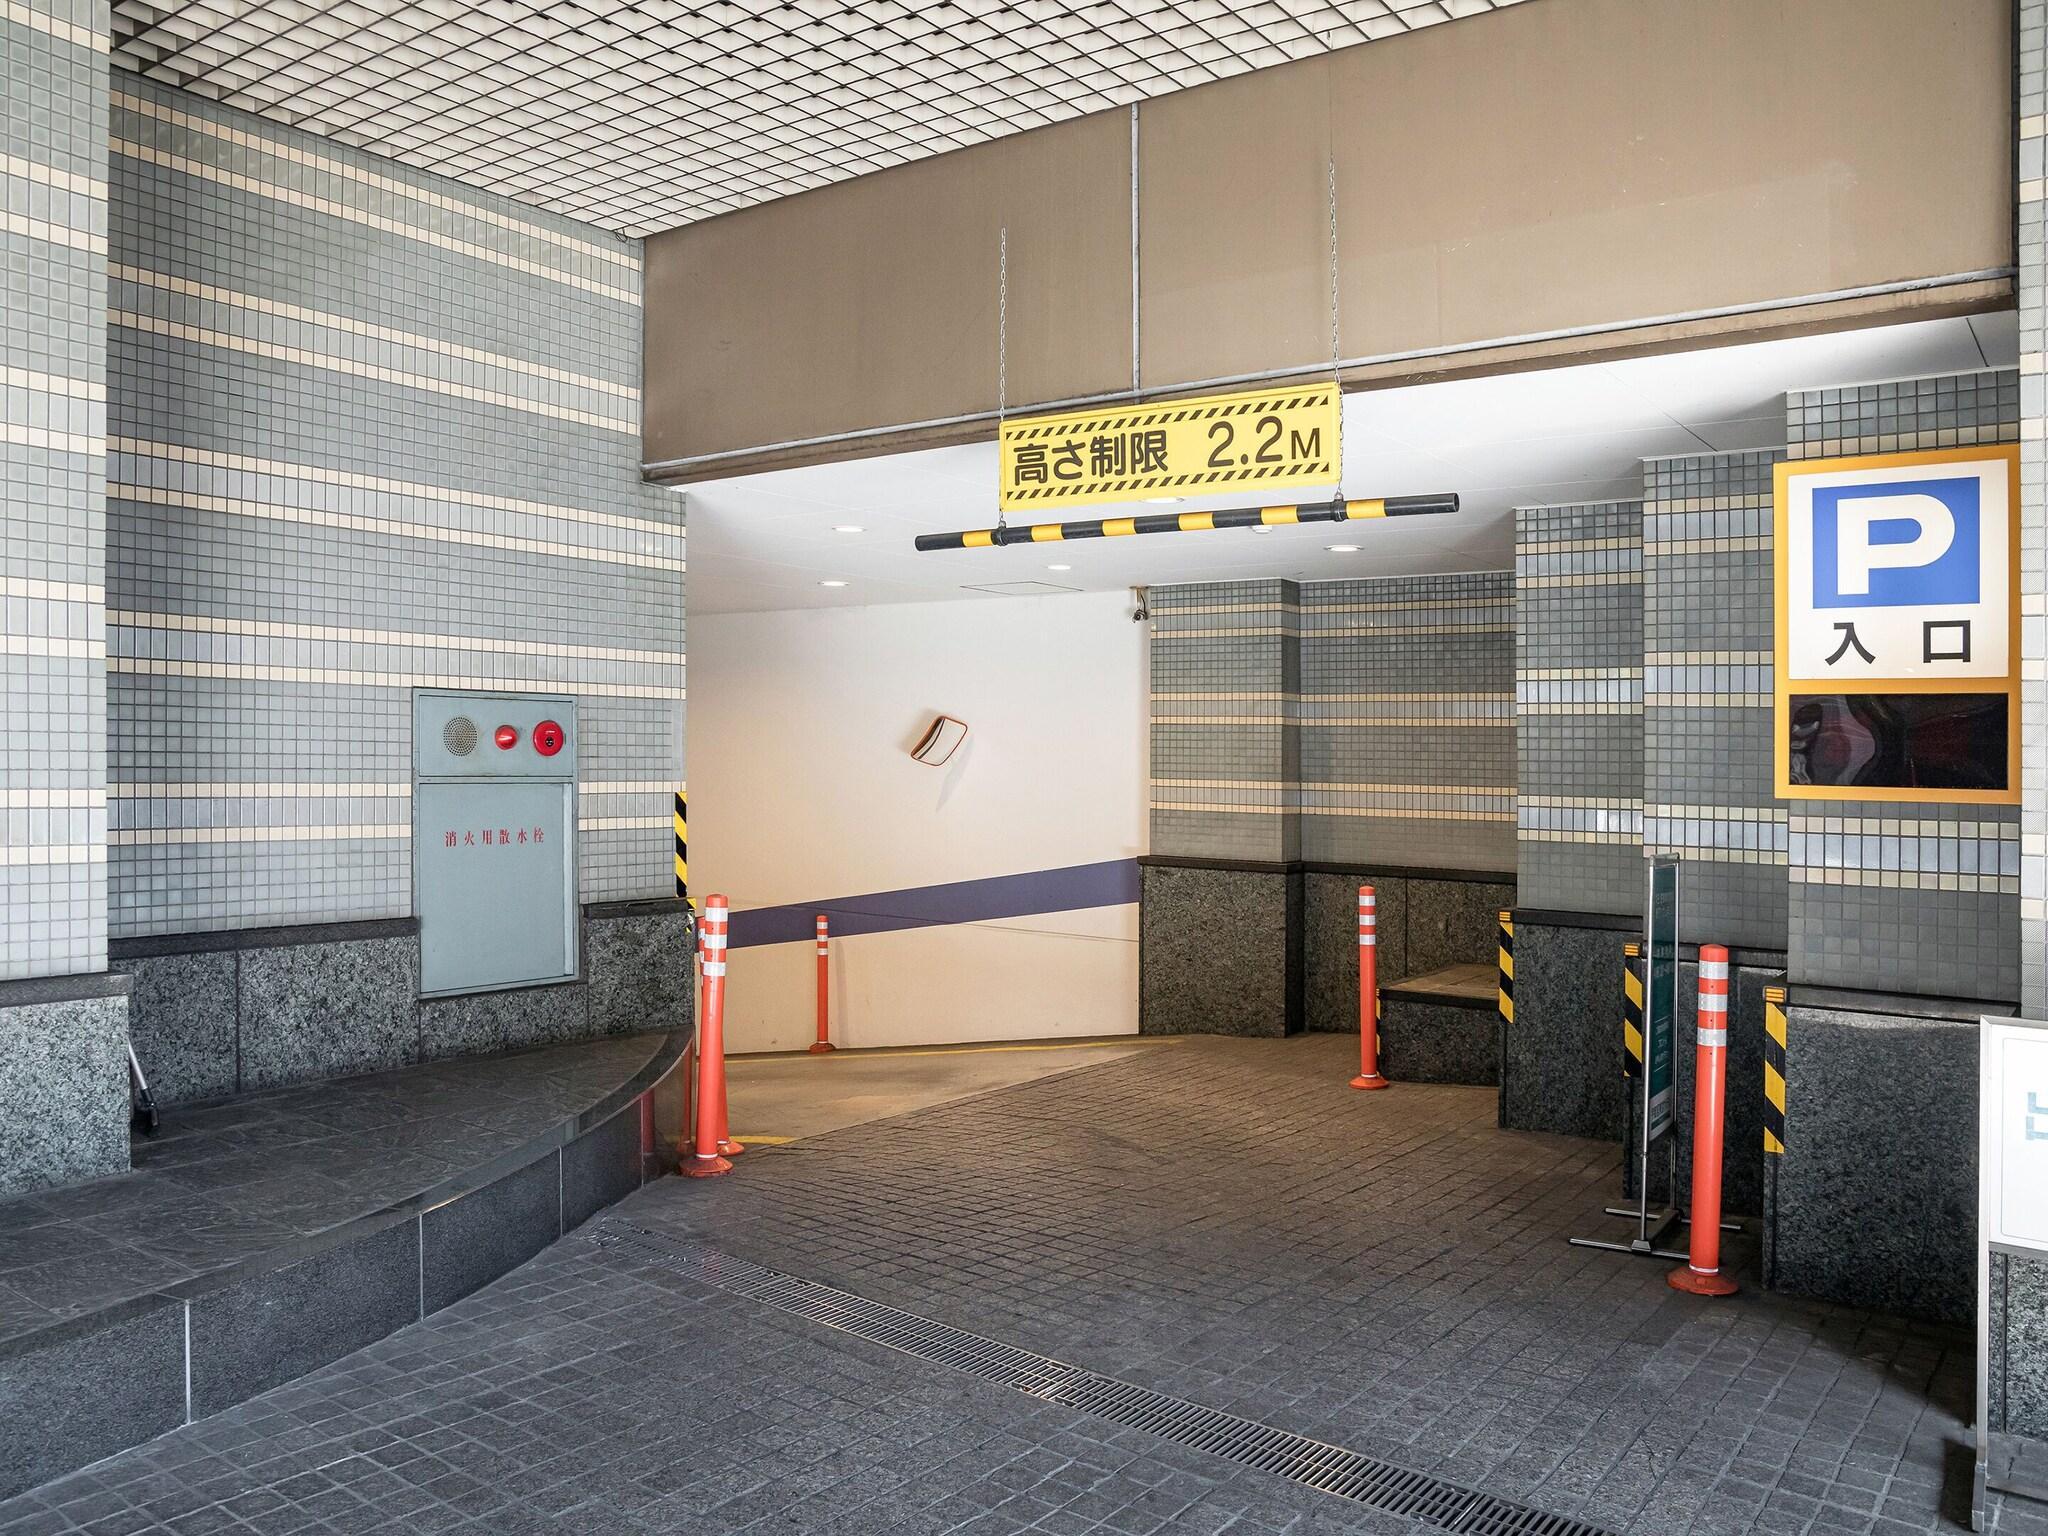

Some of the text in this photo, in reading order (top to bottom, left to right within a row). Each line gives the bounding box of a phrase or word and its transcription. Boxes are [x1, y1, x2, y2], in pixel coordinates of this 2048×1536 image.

[1013, 415, 1321, 486] 高さ制限 2.2M
[1837, 493, 1956, 596] P
[1824, 619, 1971, 666] 入口
[445, 826, 545, 848] 消火用散水栓
